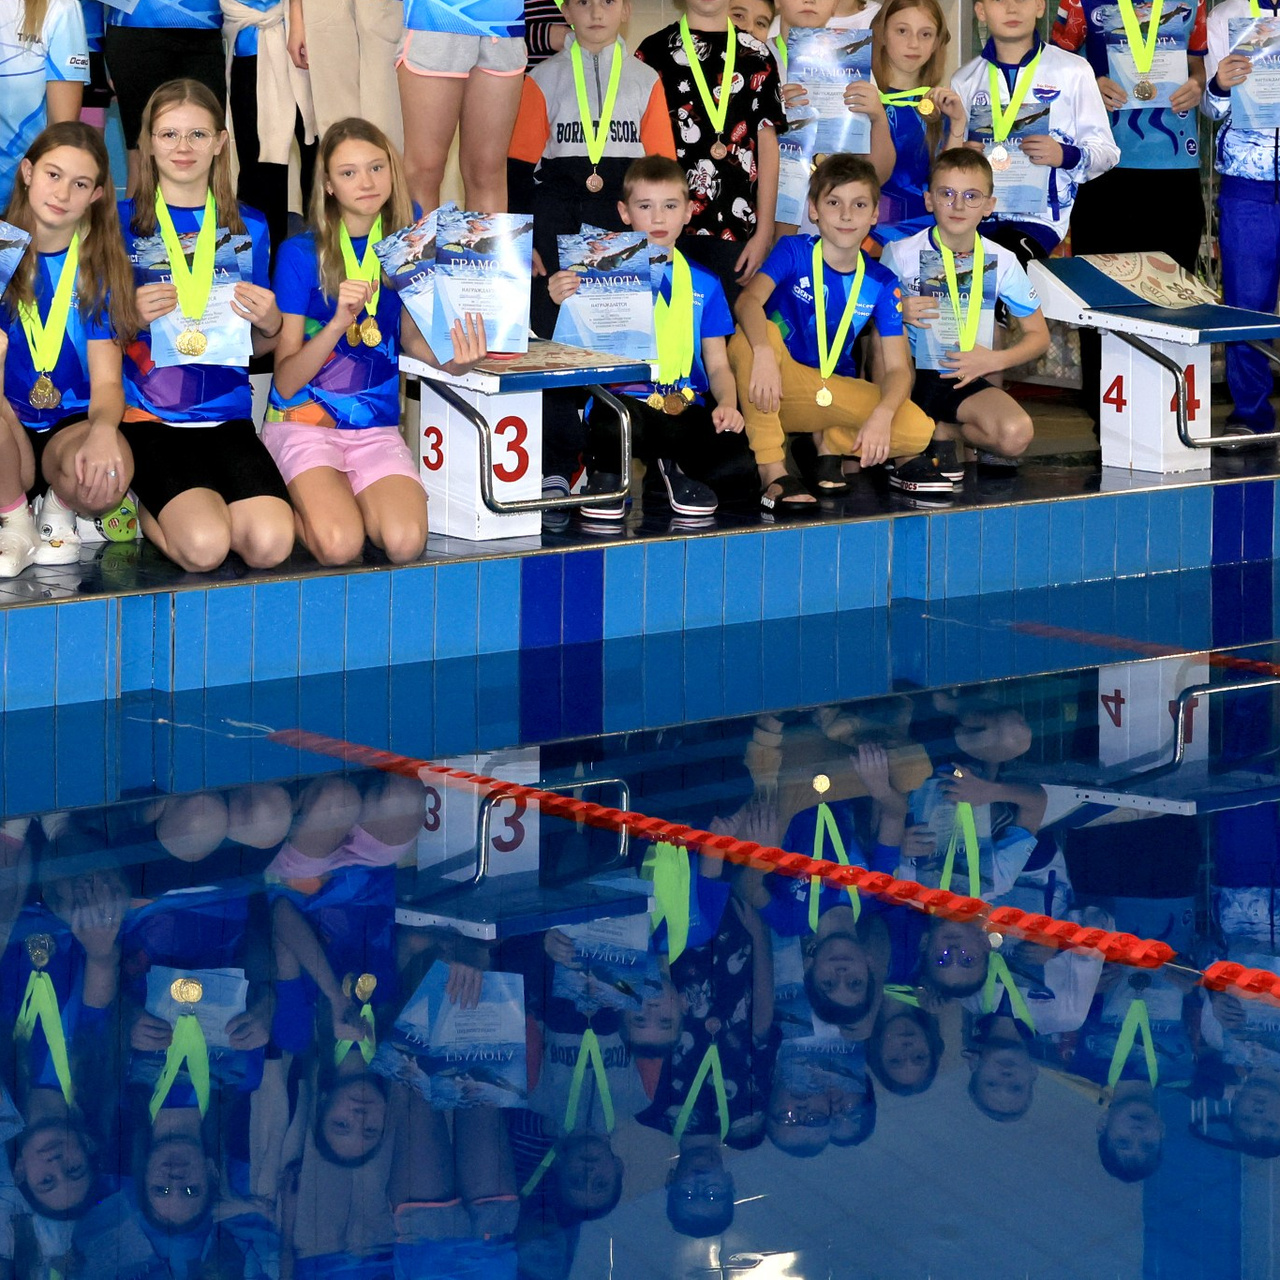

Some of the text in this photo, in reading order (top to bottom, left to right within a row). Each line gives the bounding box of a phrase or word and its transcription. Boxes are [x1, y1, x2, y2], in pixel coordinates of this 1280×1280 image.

[803, 66, 862, 78] ГРАМОТА
[609, 120, 642, 144] SCOR
[409, 265, 436, 287] ГРА
[450, 258, 501, 271] ГРАМО
[1103, 375, 1127, 413] 4
[423, 426, 444, 471] 3
[492, 415, 529, 482] 3
